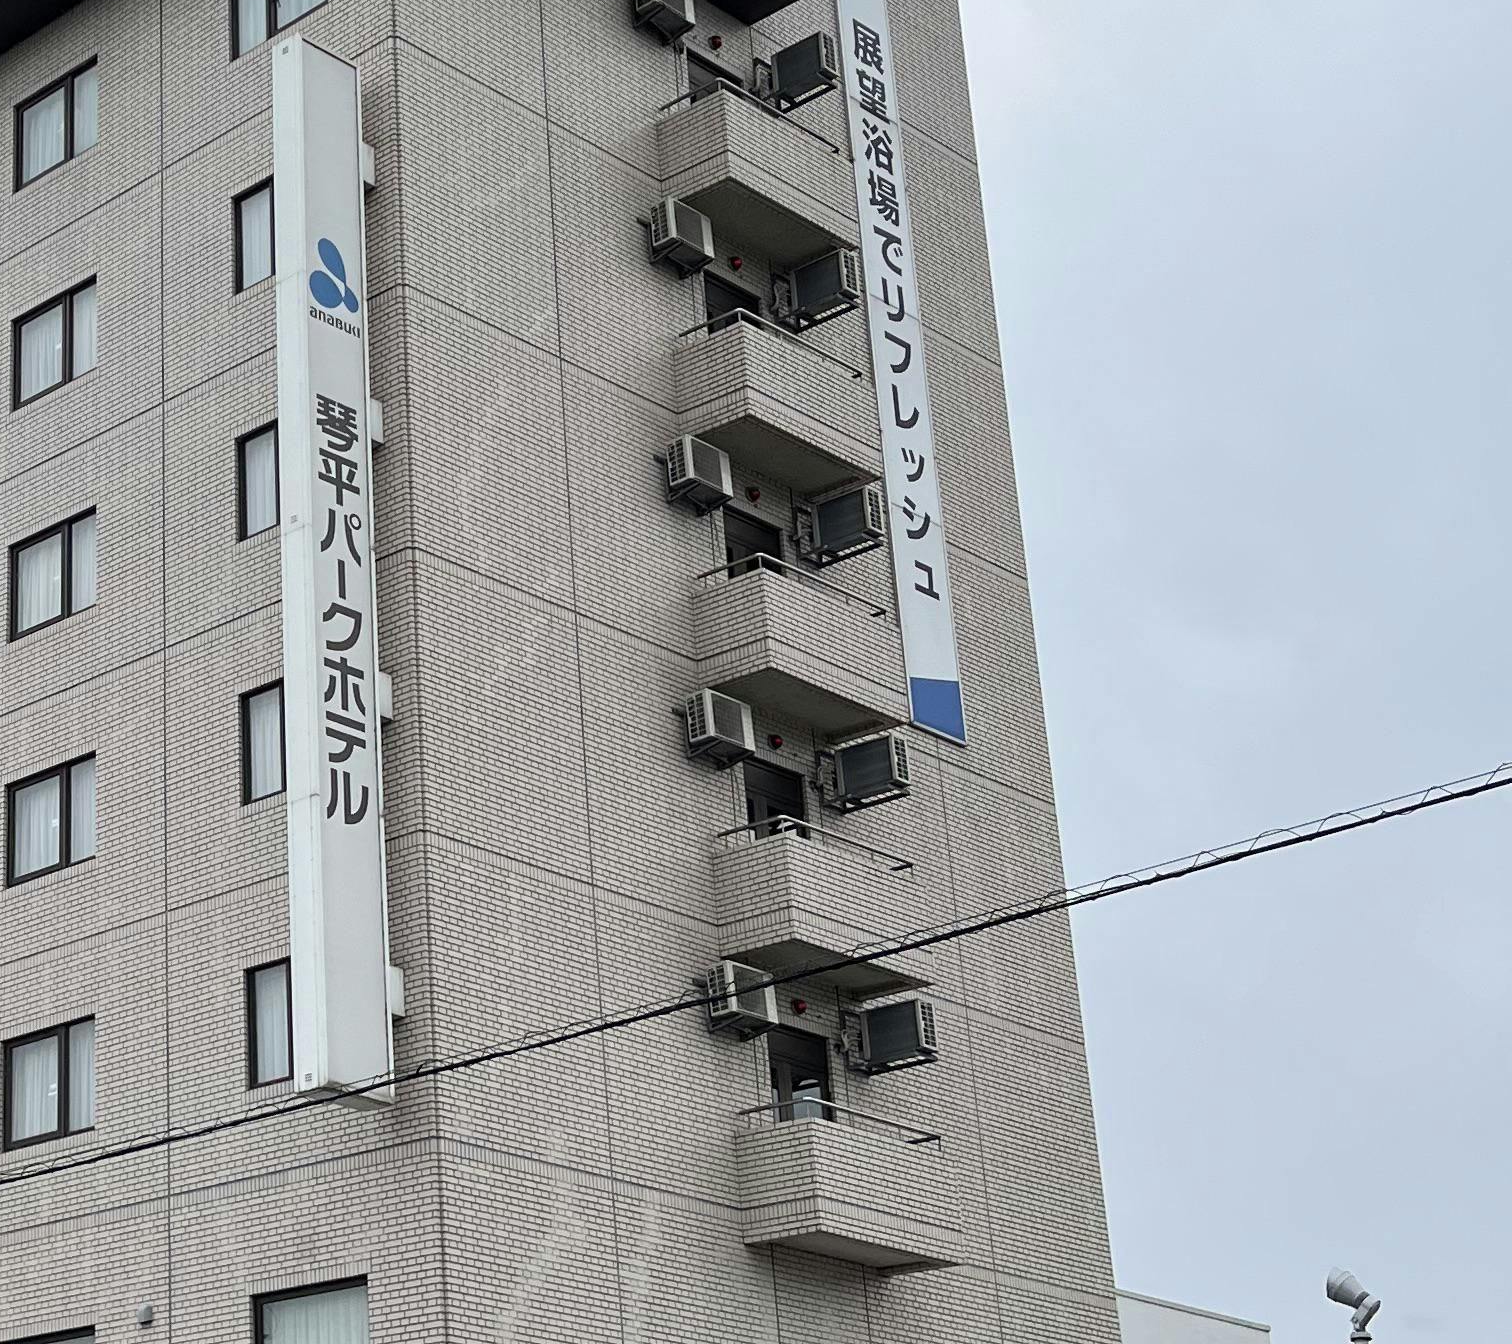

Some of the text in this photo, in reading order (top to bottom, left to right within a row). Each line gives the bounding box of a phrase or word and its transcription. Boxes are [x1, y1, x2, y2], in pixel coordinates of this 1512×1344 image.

[852, 18, 940, 601] 展望浴場でリフレッシュ
[316, 394, 369, 825] 琴平パークホテル
